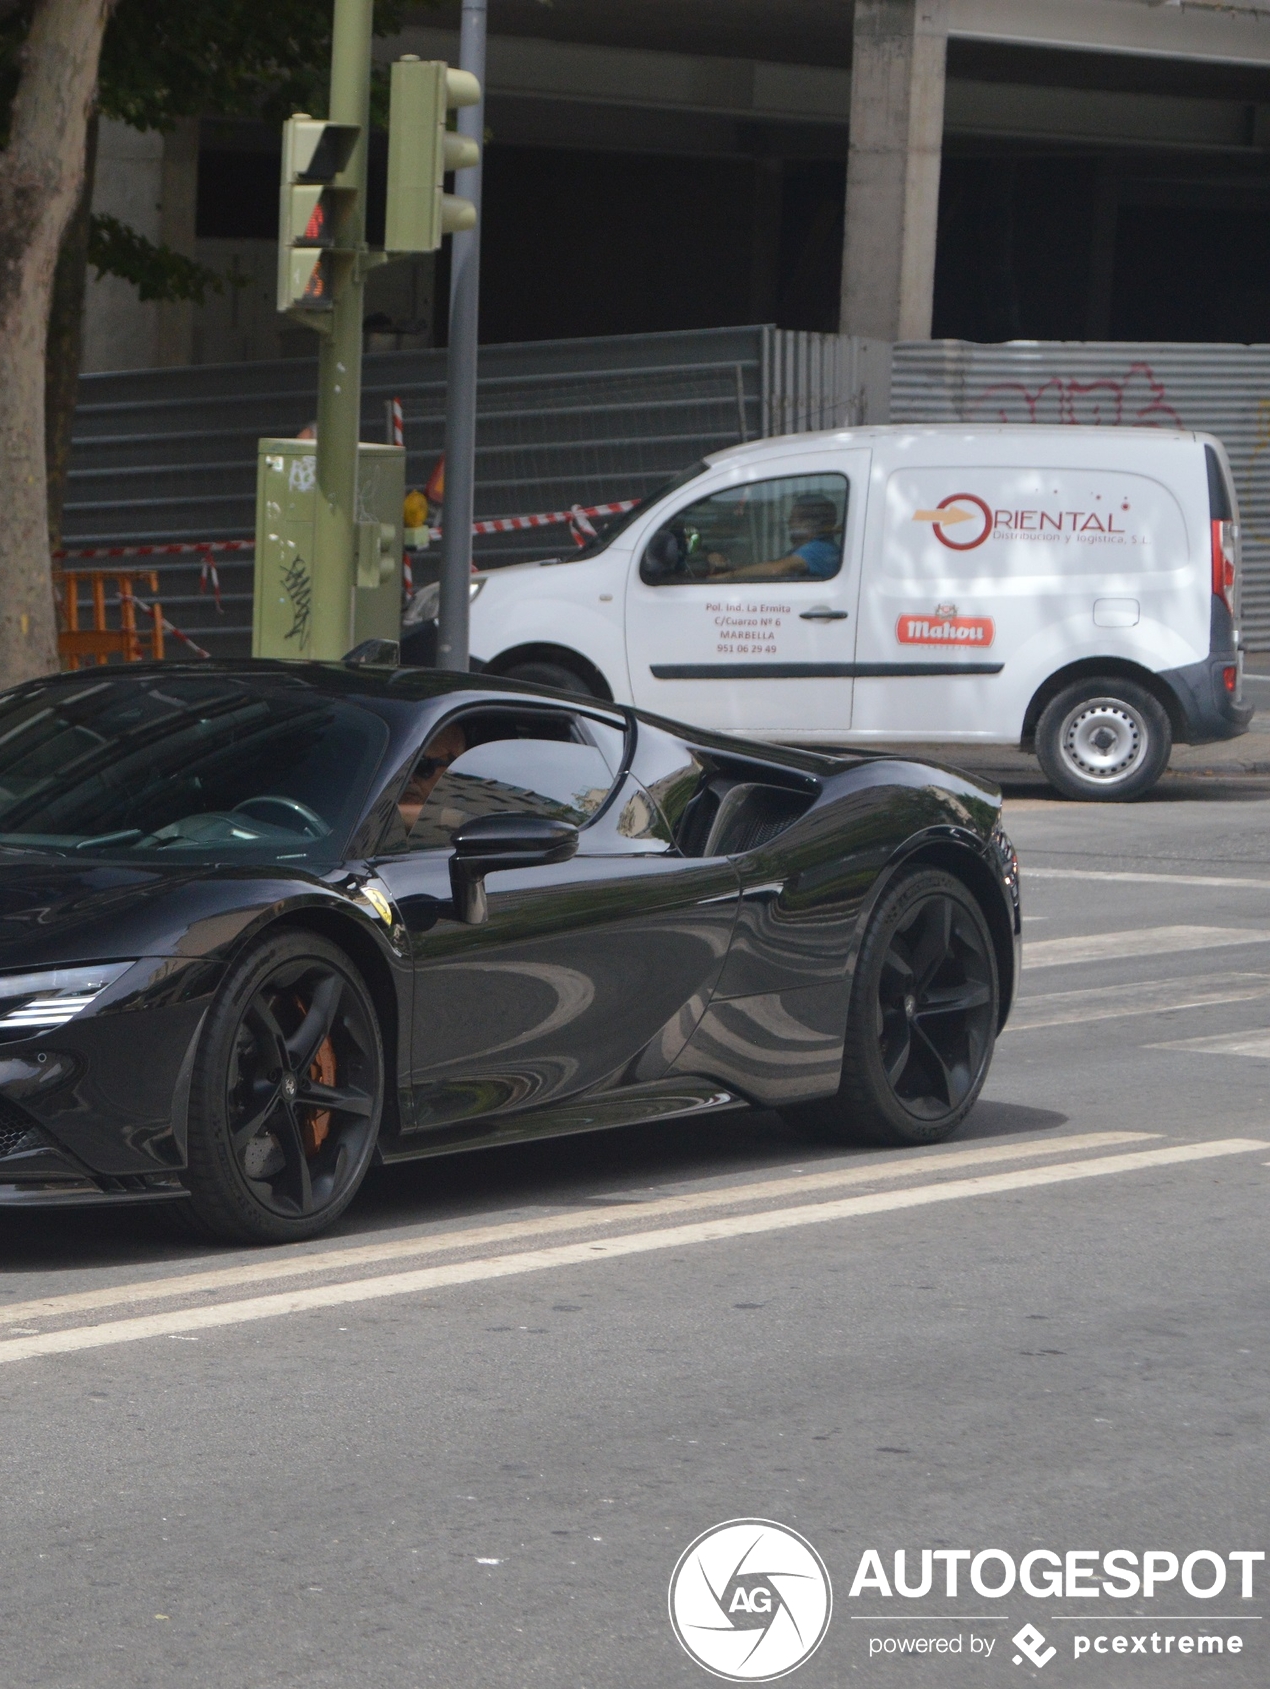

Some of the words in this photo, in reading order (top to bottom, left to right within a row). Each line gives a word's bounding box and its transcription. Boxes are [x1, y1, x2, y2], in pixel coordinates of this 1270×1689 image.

[706, 603, 723, 612] Pol.
[726, 603, 744, 612] Ind.
[747, 604, 757, 612] La
[760, 604, 791, 613] Ermita
[714, 616, 758, 626] C/Cuarzo
[775, 618, 781, 626] 6
[720, 630, 775, 640] MARBELLA
[907, 620, 984, 640] Mahou
[717, 644, 734, 653] 951
[737, 644, 749, 653] 06
[751, 645, 763, 653] 29
[765, 645, 777, 653] 49
